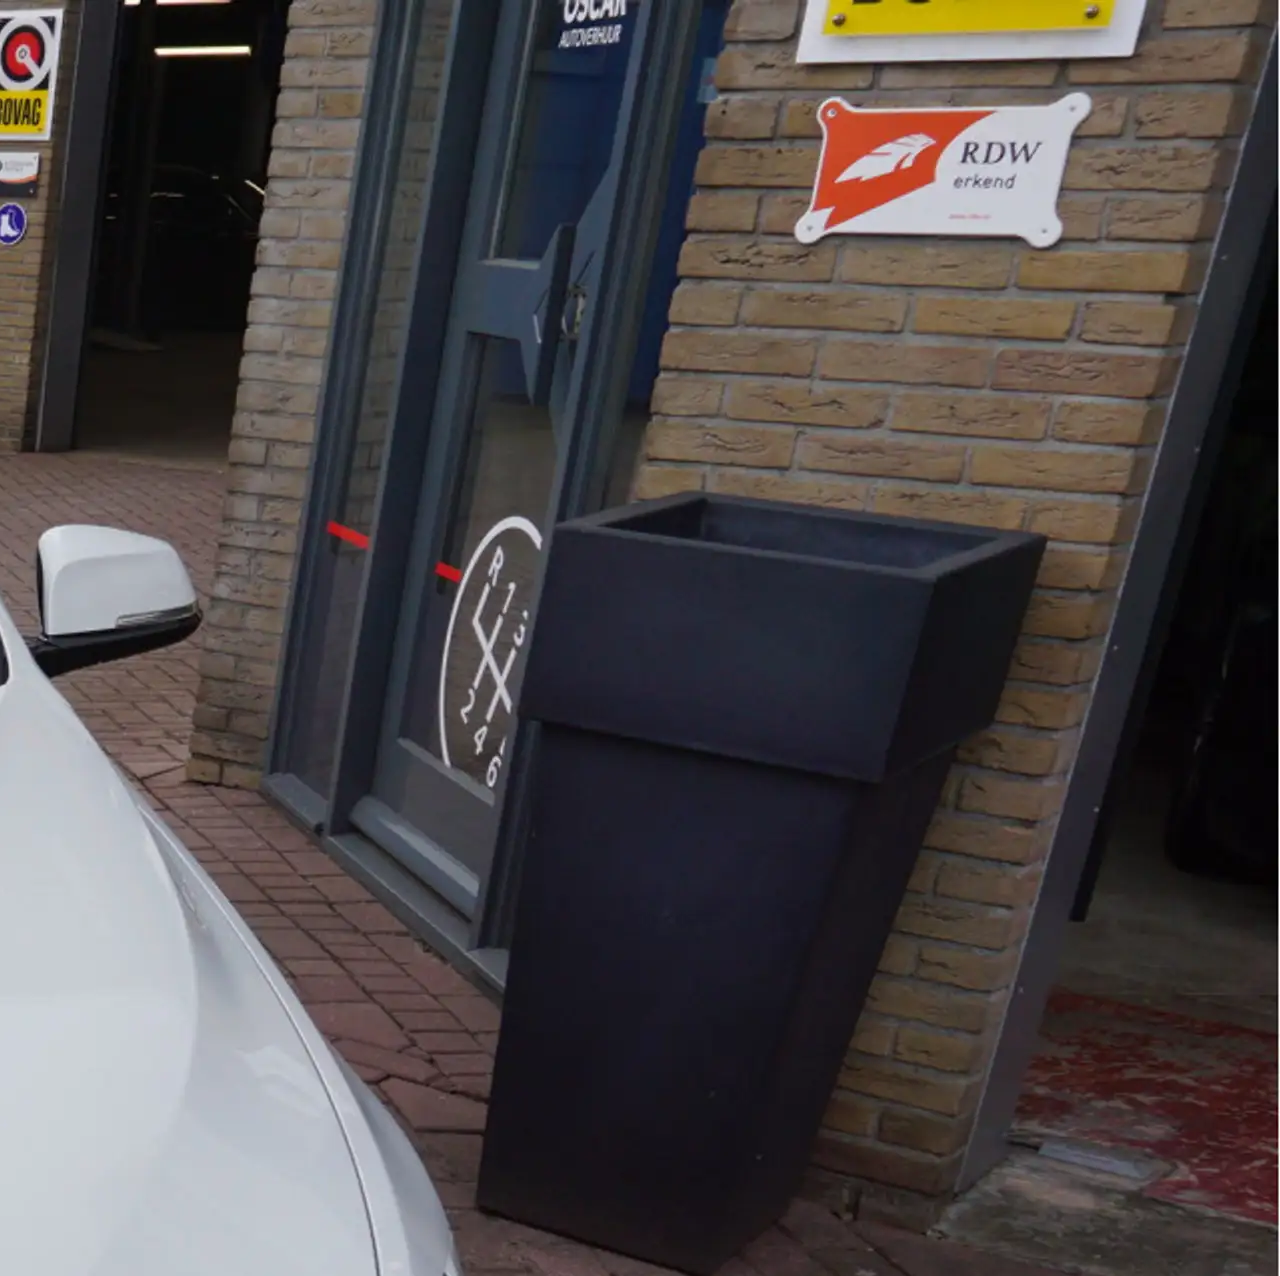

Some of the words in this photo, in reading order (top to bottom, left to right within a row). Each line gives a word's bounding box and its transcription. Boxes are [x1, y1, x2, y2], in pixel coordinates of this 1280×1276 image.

[959, 141, 1043, 165] RDW
[953, 173, 1018, 189] erkend
[488, 545, 504, 587] R
[460, 688, 475, 724] 2
